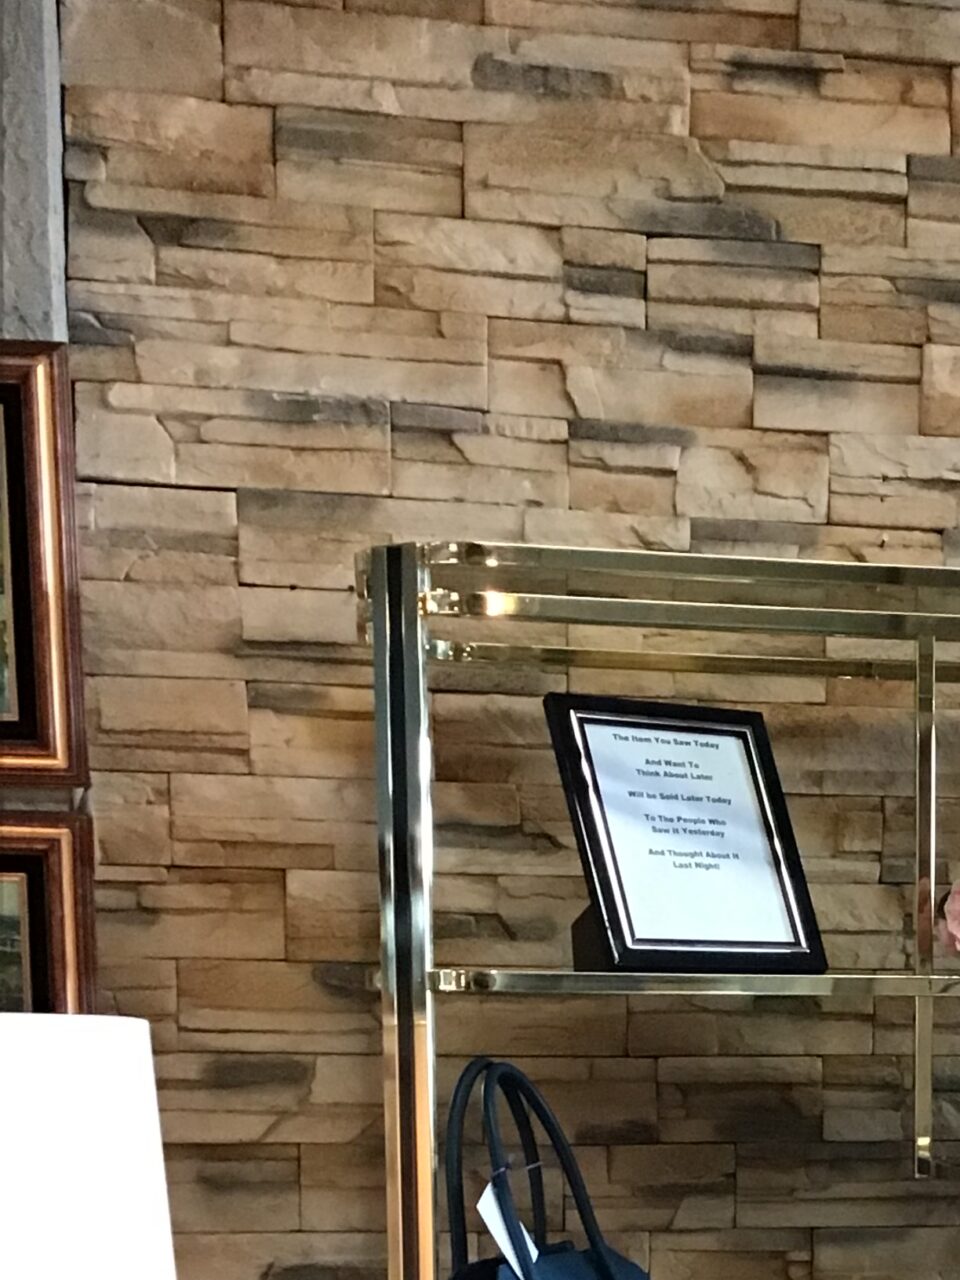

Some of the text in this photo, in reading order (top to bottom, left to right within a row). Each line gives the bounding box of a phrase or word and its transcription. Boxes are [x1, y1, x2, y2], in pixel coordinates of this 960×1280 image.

[612, 733, 629, 742] The
[654, 736, 671, 745] You
[673, 738, 692, 747] Saw
[693, 740, 720, 750] Today
[645, 758, 699, 769] And Want To
[635, 768, 713, 781] Think About Later
[628, 790, 645, 798] Will
[681, 794, 703, 802] Later
[705, 796, 732, 806] Today
[644, 813, 727, 826] To The People Who
[651, 825, 670, 834] Saw
[681, 827, 725, 839] Yesterday
[648, 848, 665, 856] And
[667, 849, 703, 859] Thought
[706, 851, 731, 860] About
[672, 860, 692, 869] Last
